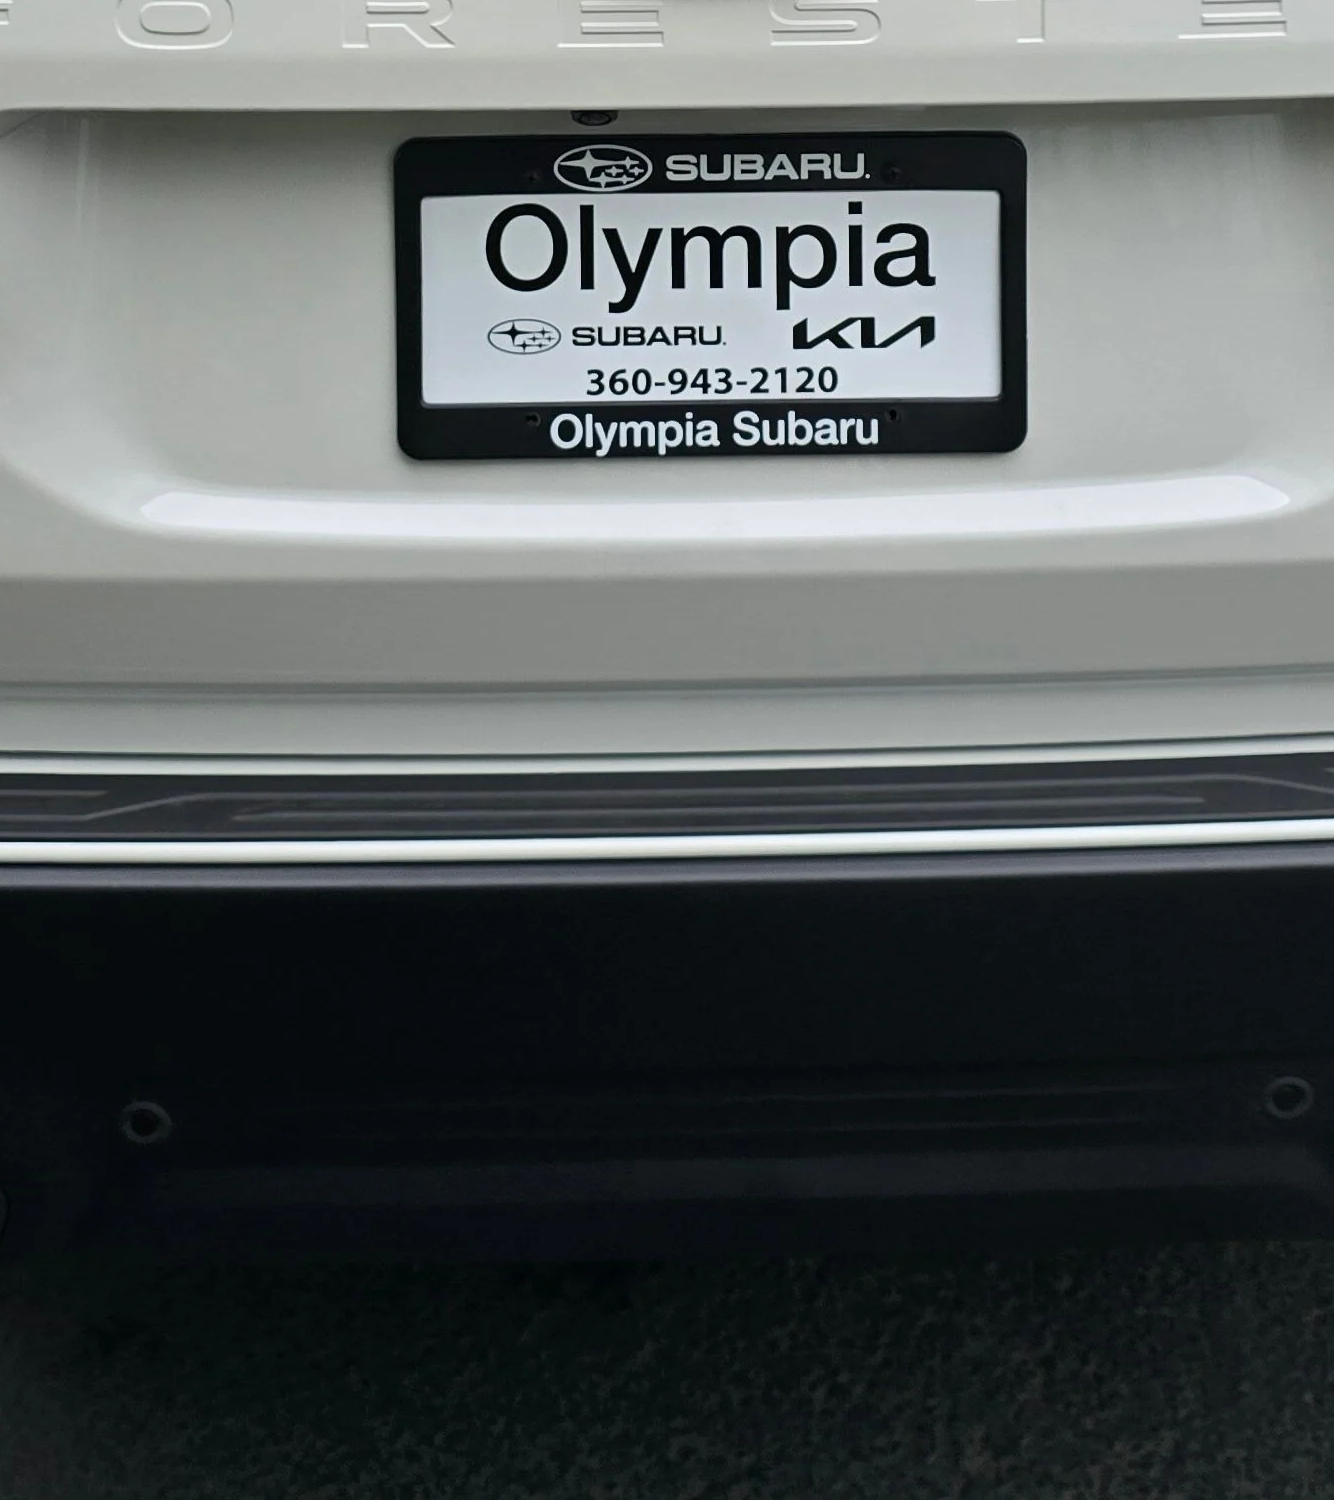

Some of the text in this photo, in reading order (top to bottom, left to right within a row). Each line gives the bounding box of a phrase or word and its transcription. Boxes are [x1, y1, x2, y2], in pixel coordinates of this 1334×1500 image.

[485, 201, 936, 313] Olympia
[585, 366, 838, 396] 360-943-2120
[550, 410, 879, 456] Olympia Subaru
